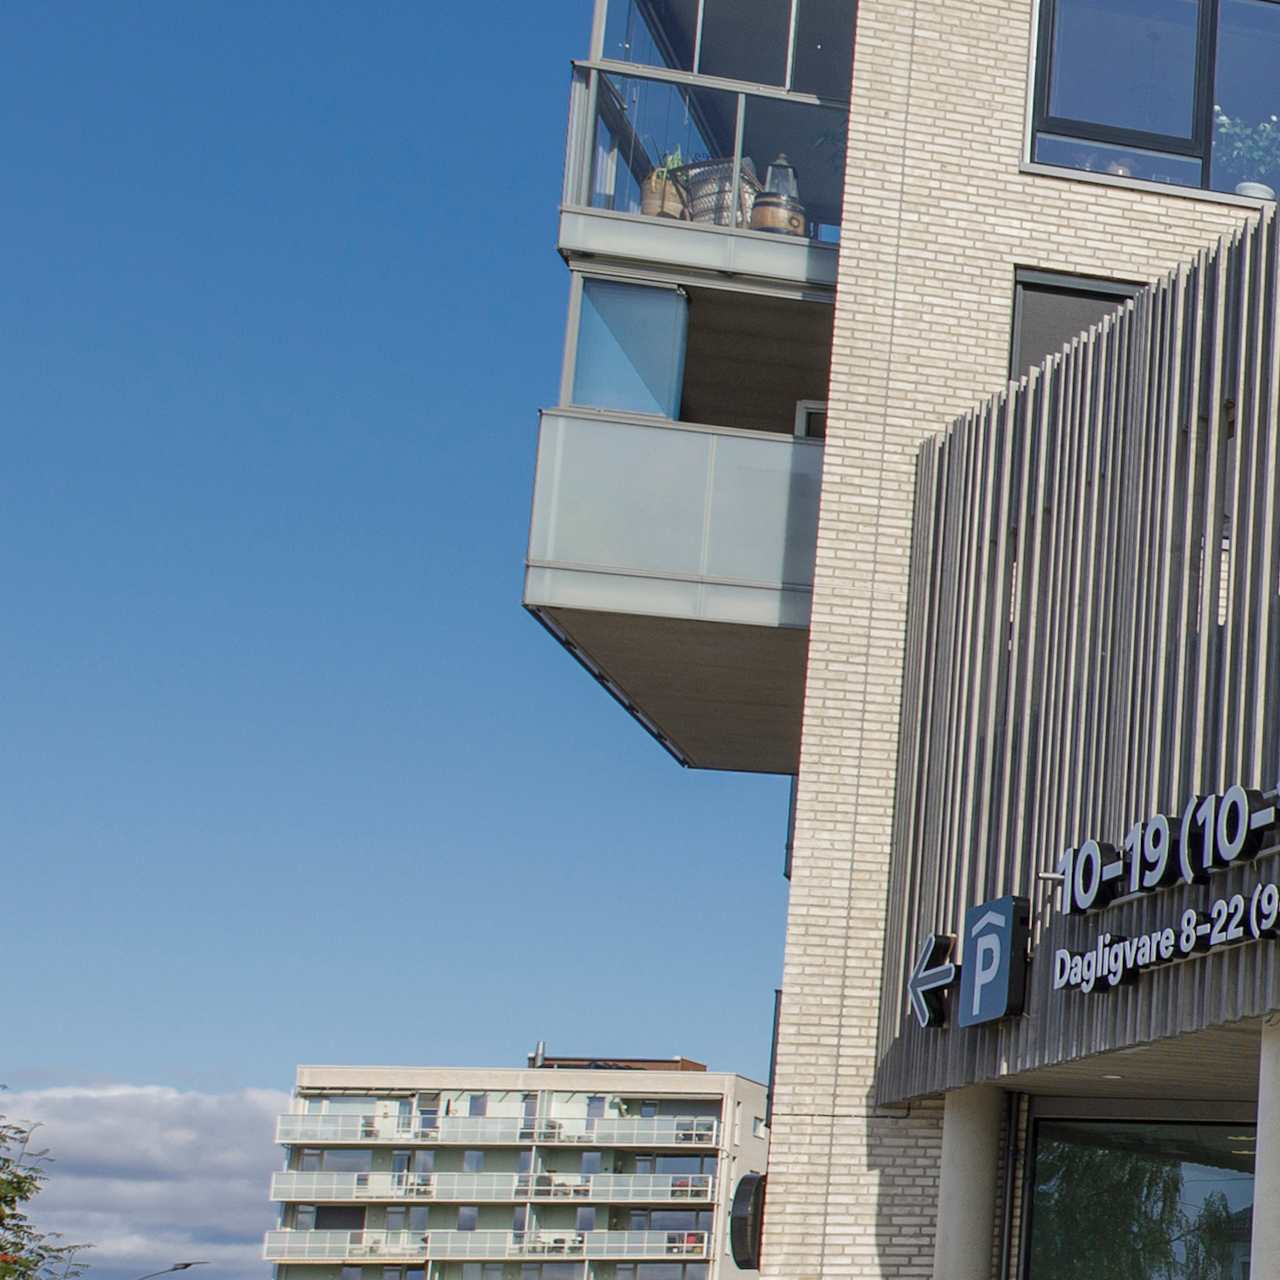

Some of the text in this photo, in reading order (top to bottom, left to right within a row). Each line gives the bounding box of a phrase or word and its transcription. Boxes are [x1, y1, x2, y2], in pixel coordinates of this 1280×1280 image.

[1058, 814, 1170, 915] 10-19
[972, 933, 1002, 1016] P
[1054, 925, 1175, 994] Dagligvare
[1180, 894, 1244, 953] 8-22
